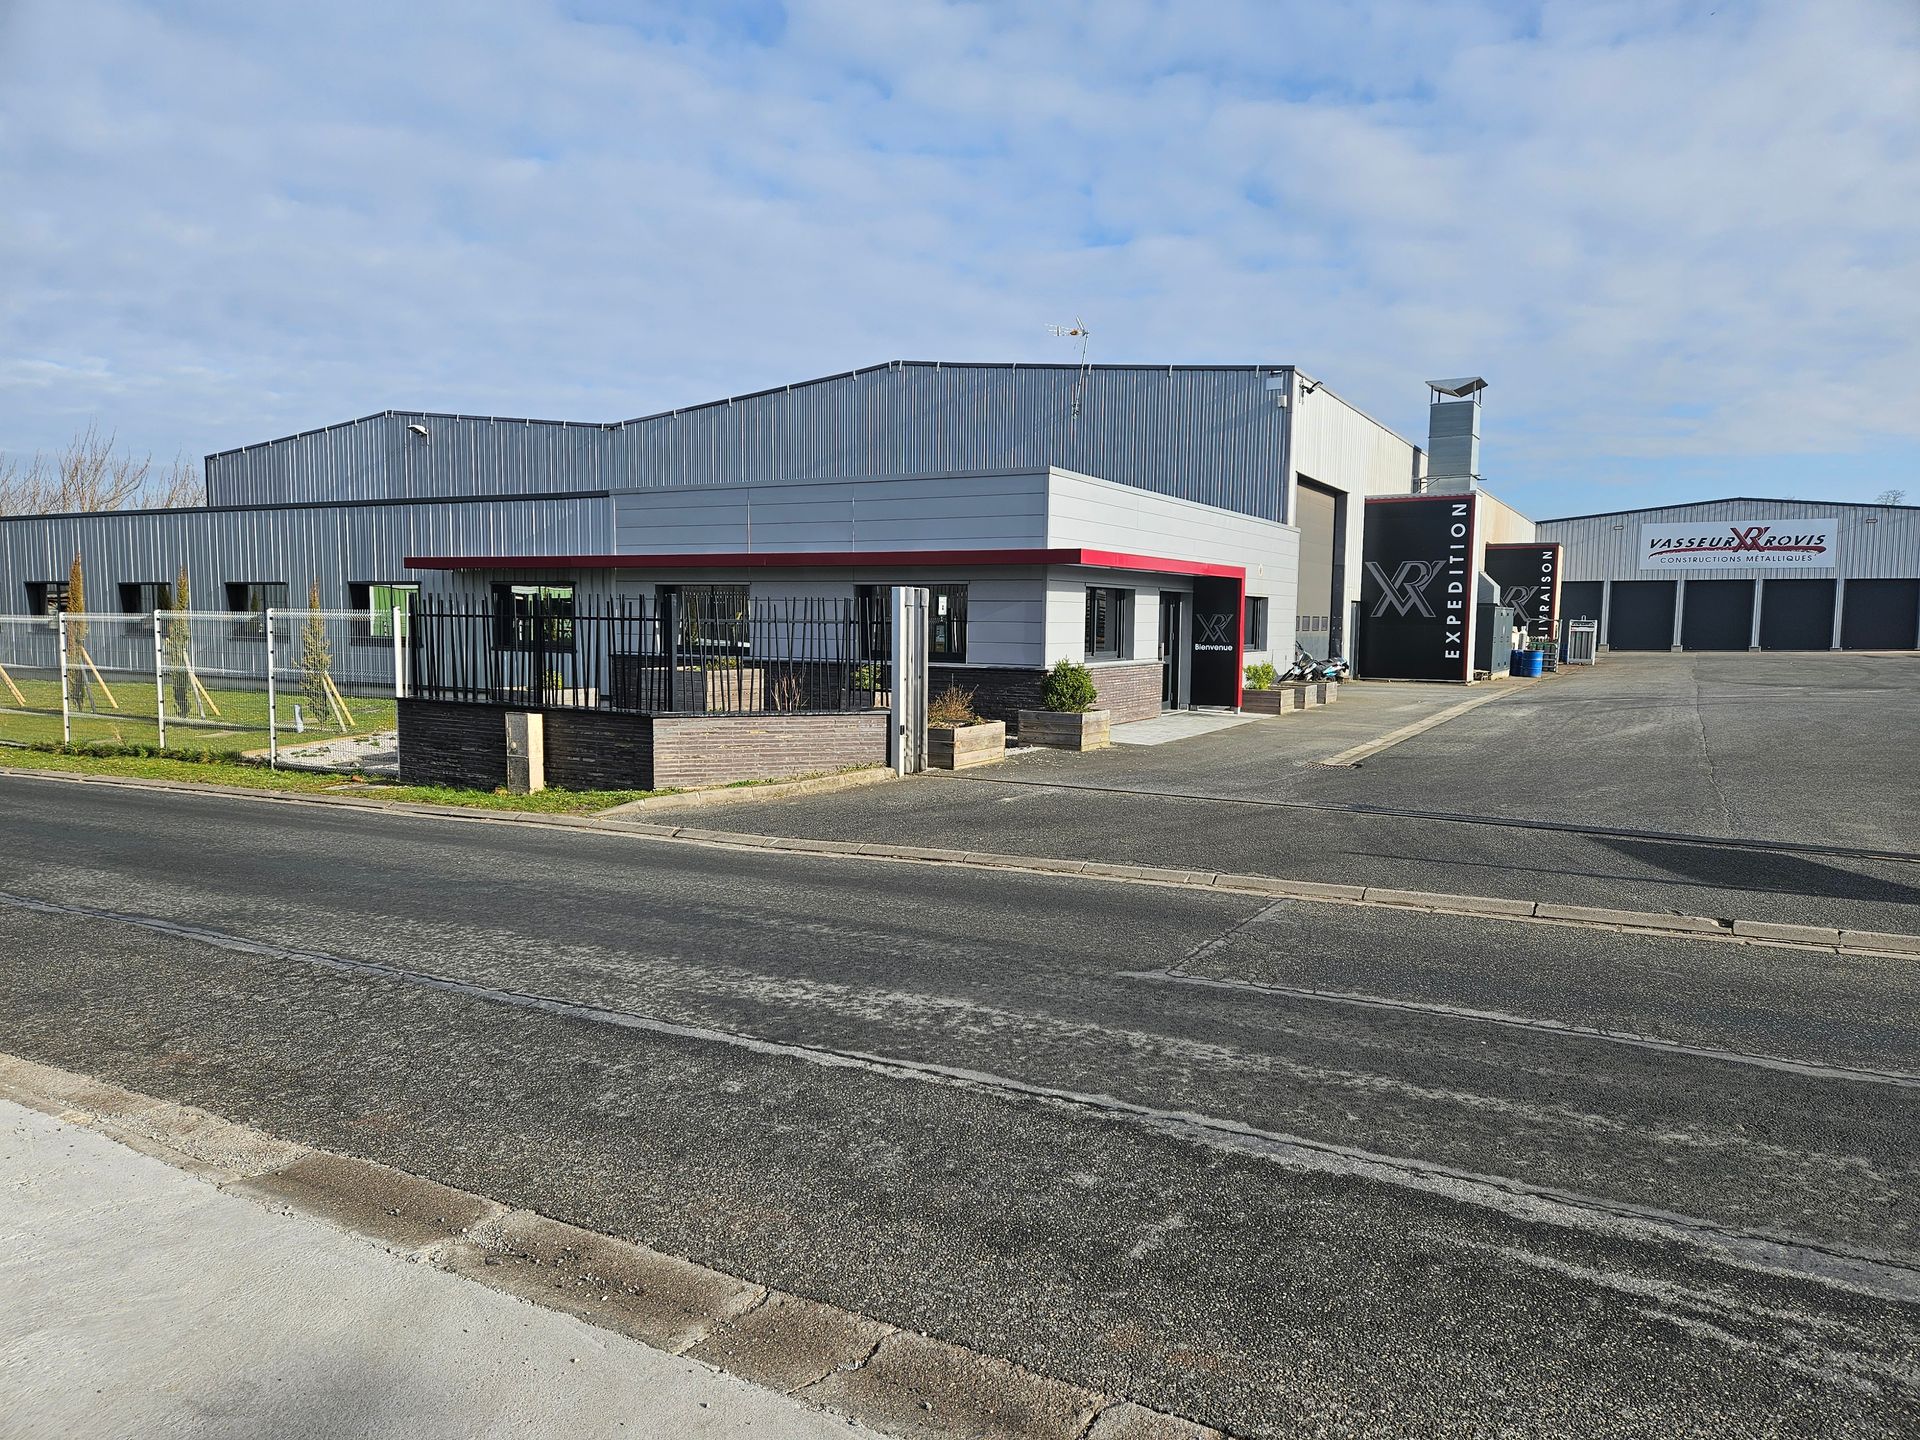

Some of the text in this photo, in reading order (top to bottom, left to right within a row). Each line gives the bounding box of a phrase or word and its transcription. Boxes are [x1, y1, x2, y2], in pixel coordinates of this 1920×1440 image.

[1650, 537, 1736, 549] VASSEUR
[1764, 534, 1826, 546] ROVIS
[1660, 554, 1813, 564] CONSTRUCTIONS MÉTALLIQUES
[1445, 503, 1467, 659] EXPEDITION
[1194, 643, 1233, 651] Bienvenue
